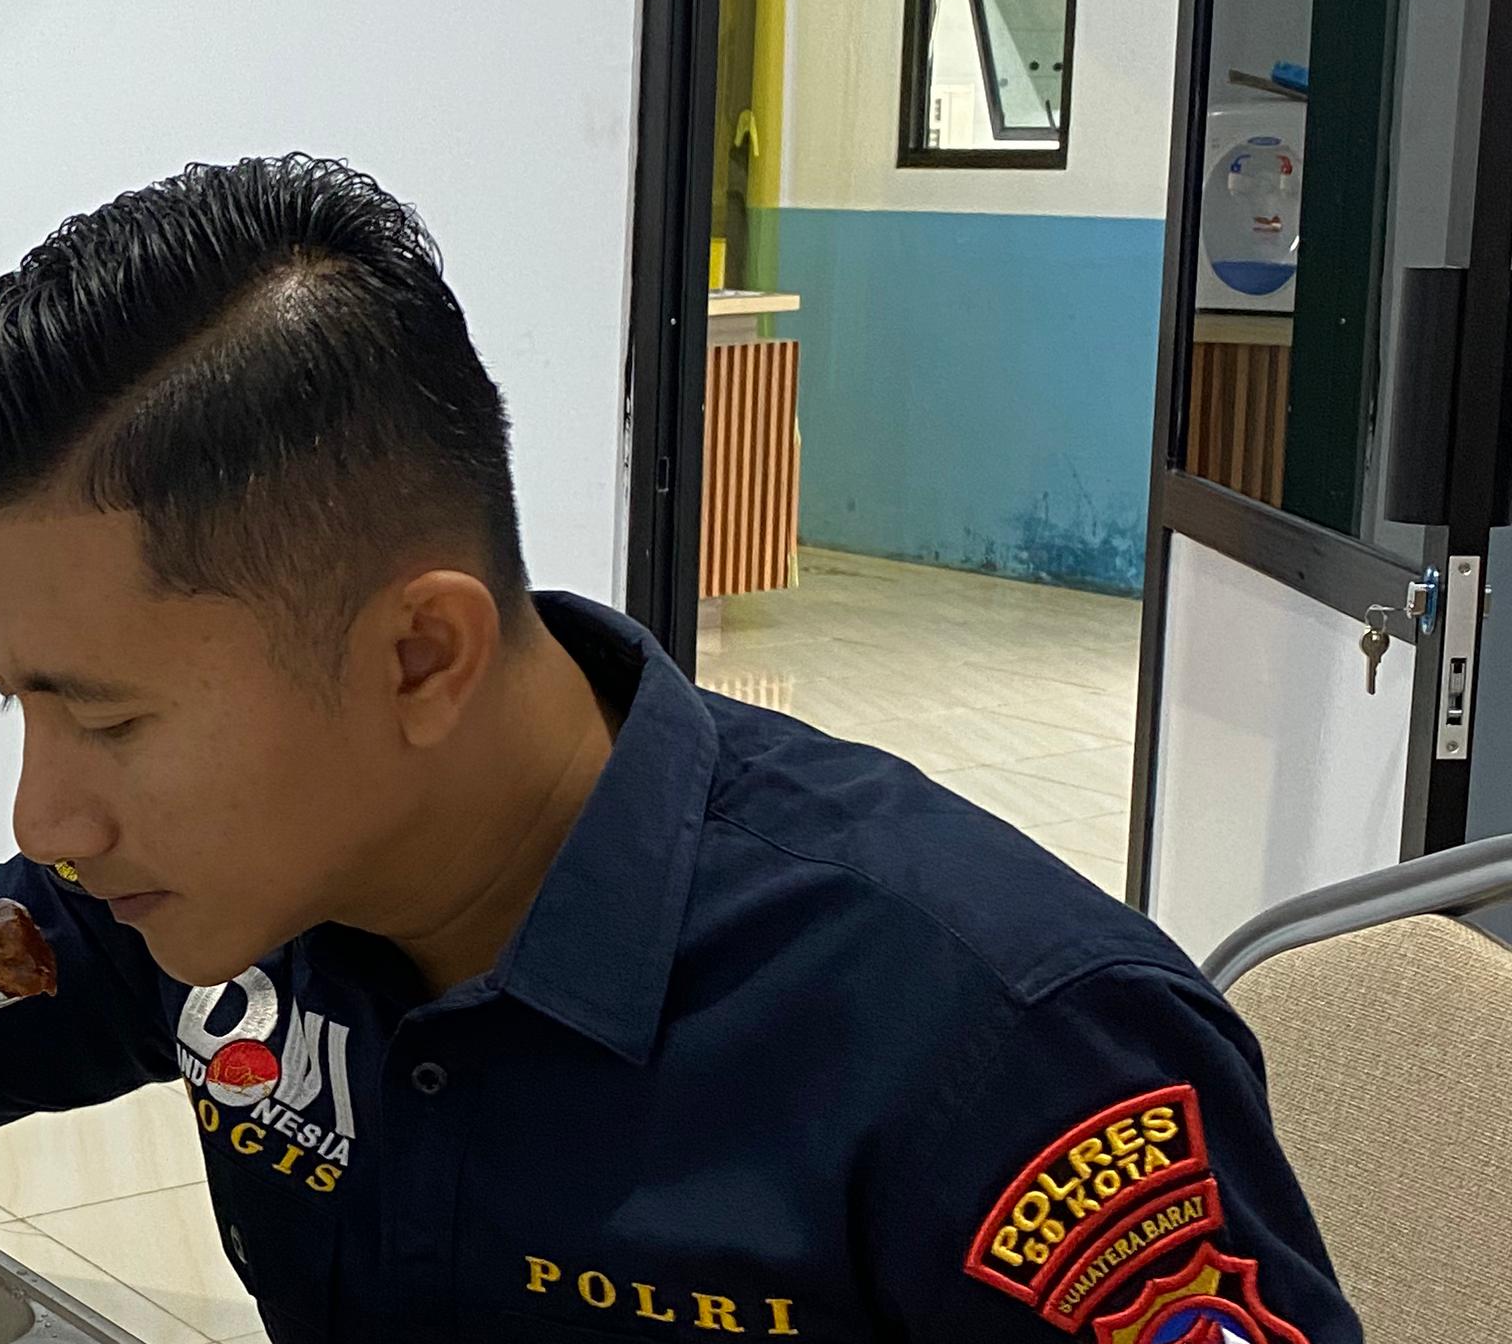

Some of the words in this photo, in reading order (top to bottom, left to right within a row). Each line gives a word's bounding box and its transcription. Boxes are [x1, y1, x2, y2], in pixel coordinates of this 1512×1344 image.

[198, 1099, 343, 1193] OGIS
[991, 1106, 1179, 1266] POLRES
[1066, 1144, 1171, 1218] KOTA
[525, 1256, 798, 1334] POLRI
